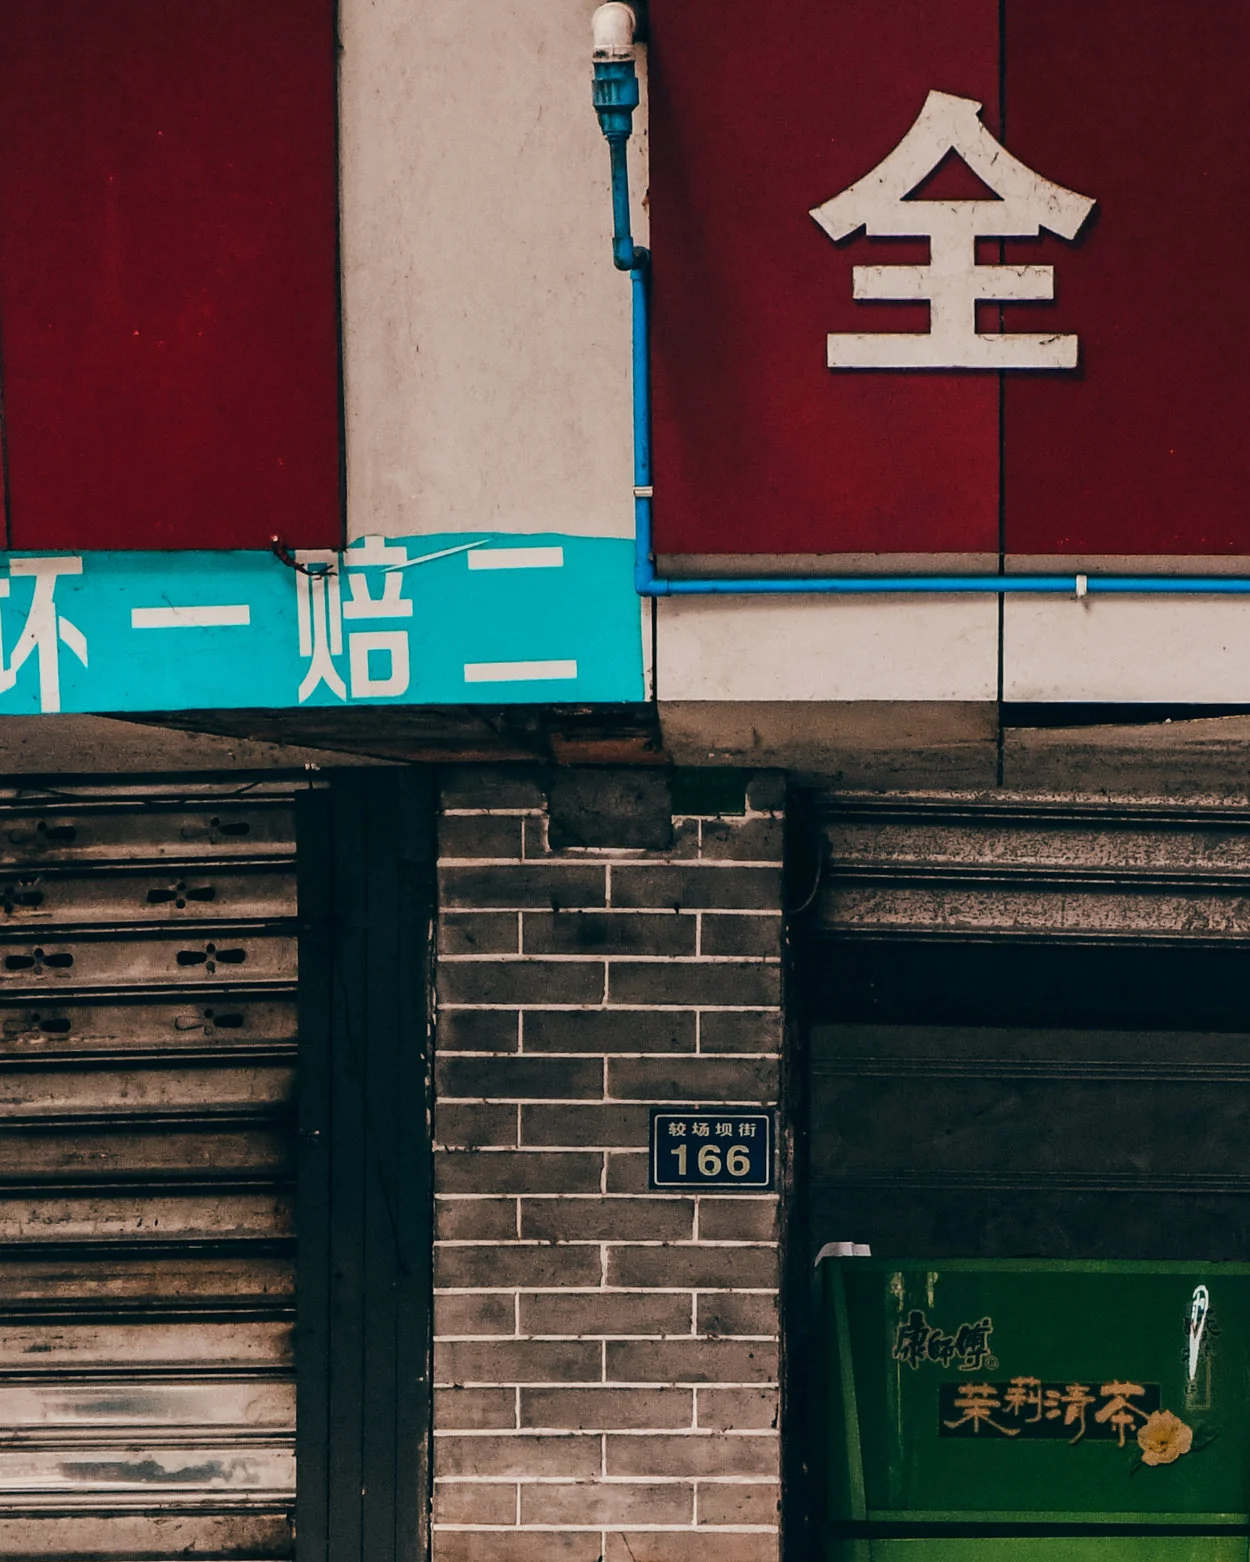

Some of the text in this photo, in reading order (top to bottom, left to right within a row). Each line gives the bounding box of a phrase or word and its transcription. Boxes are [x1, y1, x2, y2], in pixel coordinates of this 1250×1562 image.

[668, 1122, 756, 1137] 较场坝街
[670, 1144, 750, 1176] 166
[945, 1376, 1152, 1447] 茉莉清茶
